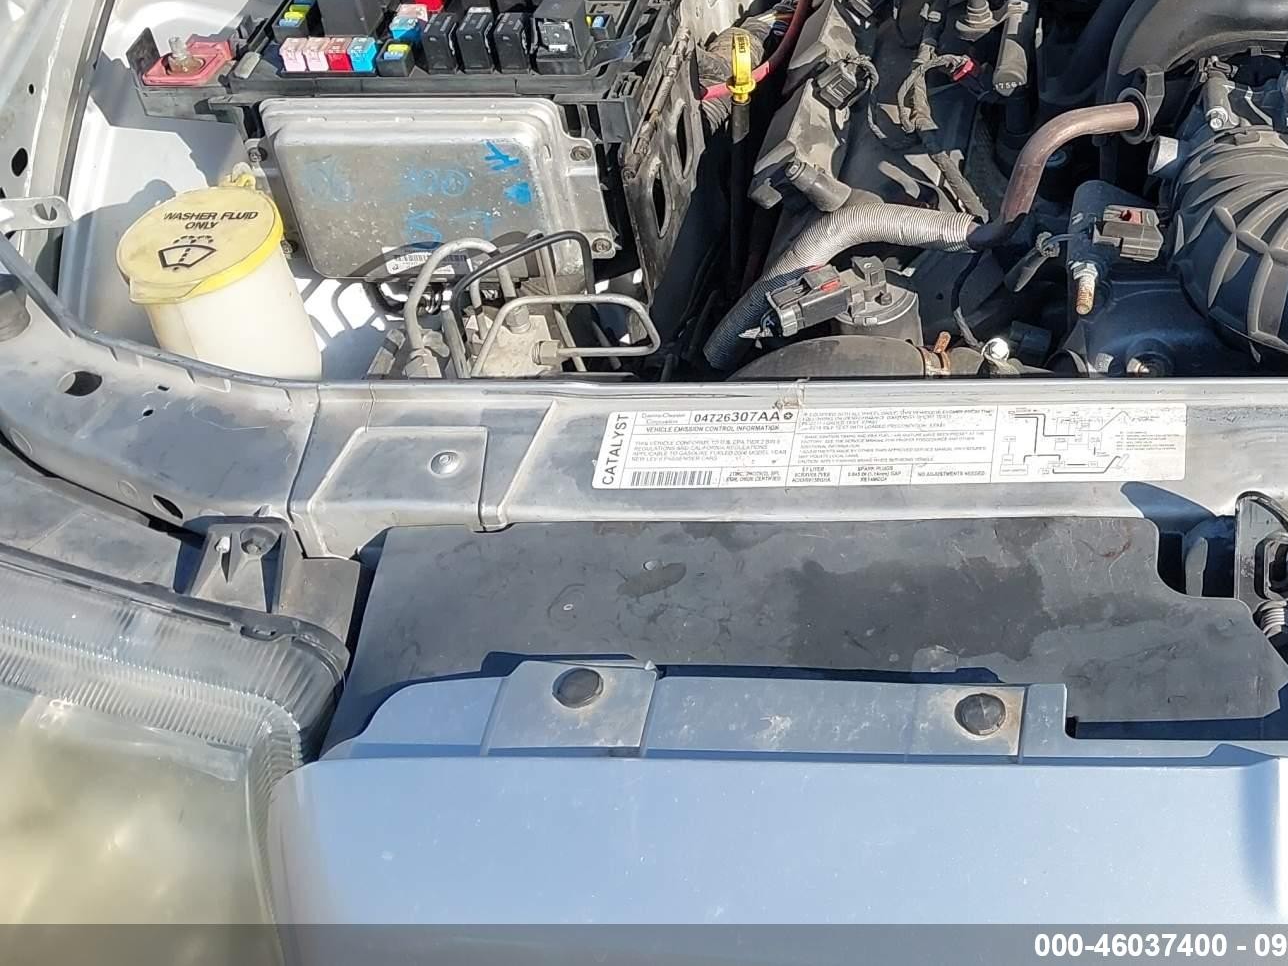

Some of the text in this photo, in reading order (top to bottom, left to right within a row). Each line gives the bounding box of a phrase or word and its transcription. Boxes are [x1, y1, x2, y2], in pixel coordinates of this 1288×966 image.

[164, 212, 258, 221] WASHER FLUID
[185, 221, 218, 230] ONLY
[694, 411, 780, 424] 04726307AA
[602, 414, 629, 485] CATALYST
